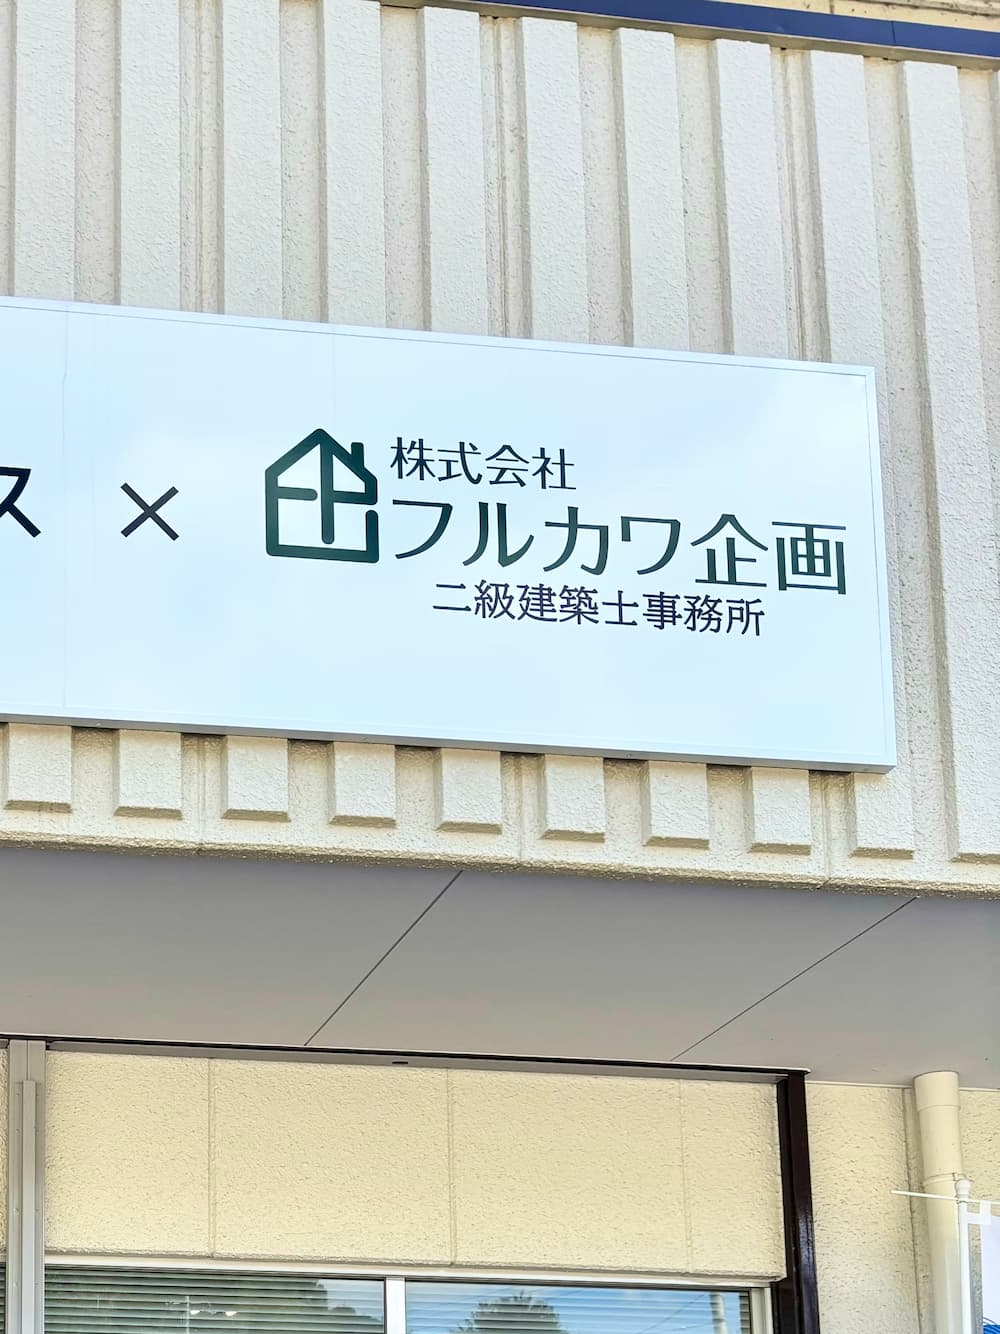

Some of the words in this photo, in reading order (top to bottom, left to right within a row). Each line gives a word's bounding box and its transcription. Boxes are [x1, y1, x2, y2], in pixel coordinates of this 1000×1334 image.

[390, 437, 576, 490] 株式会社
[392, 499, 847, 595] フルカワ企画
[432, 580, 765, 637] 二級建築士事務所
